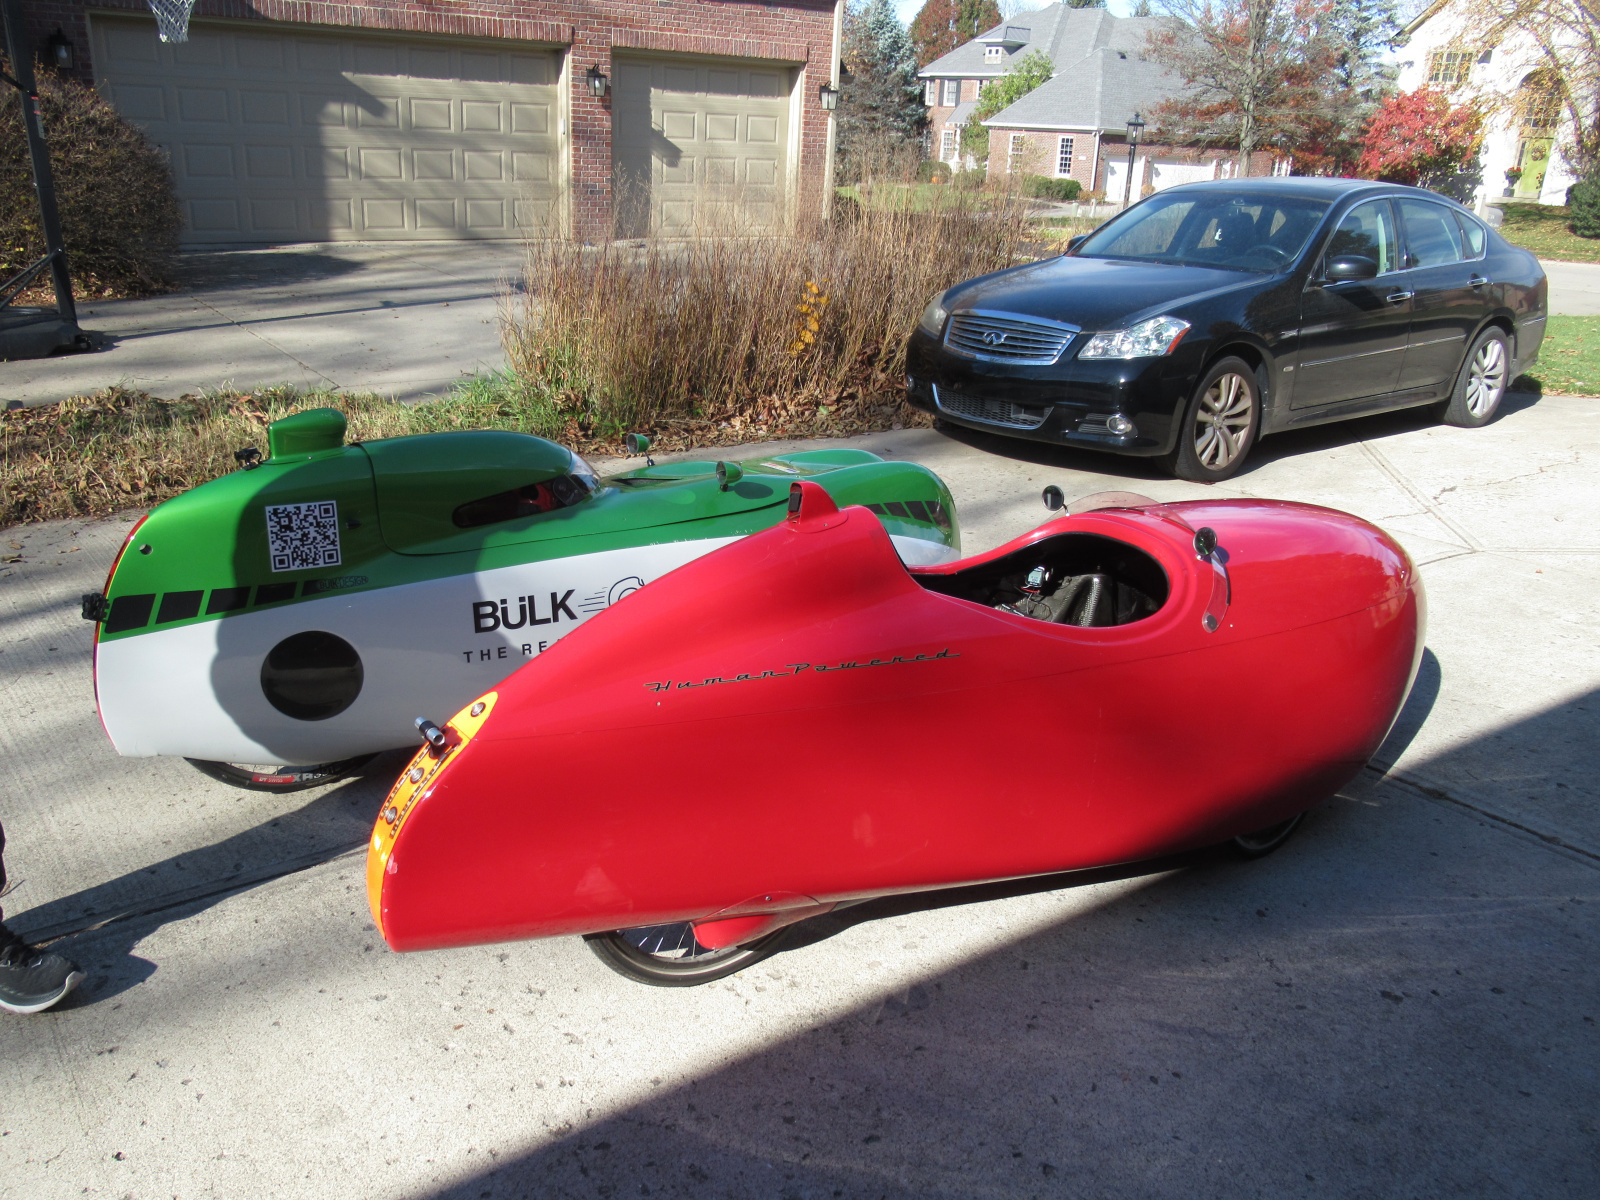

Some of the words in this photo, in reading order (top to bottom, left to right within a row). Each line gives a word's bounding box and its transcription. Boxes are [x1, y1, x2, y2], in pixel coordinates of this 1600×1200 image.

[472, 589, 578, 633] BÜLK
[463, 646, 507, 663] THE
[522, 639, 561, 655] RE
[644, 669, 790, 692] Human
[785, 648, 961, 674] Powered
